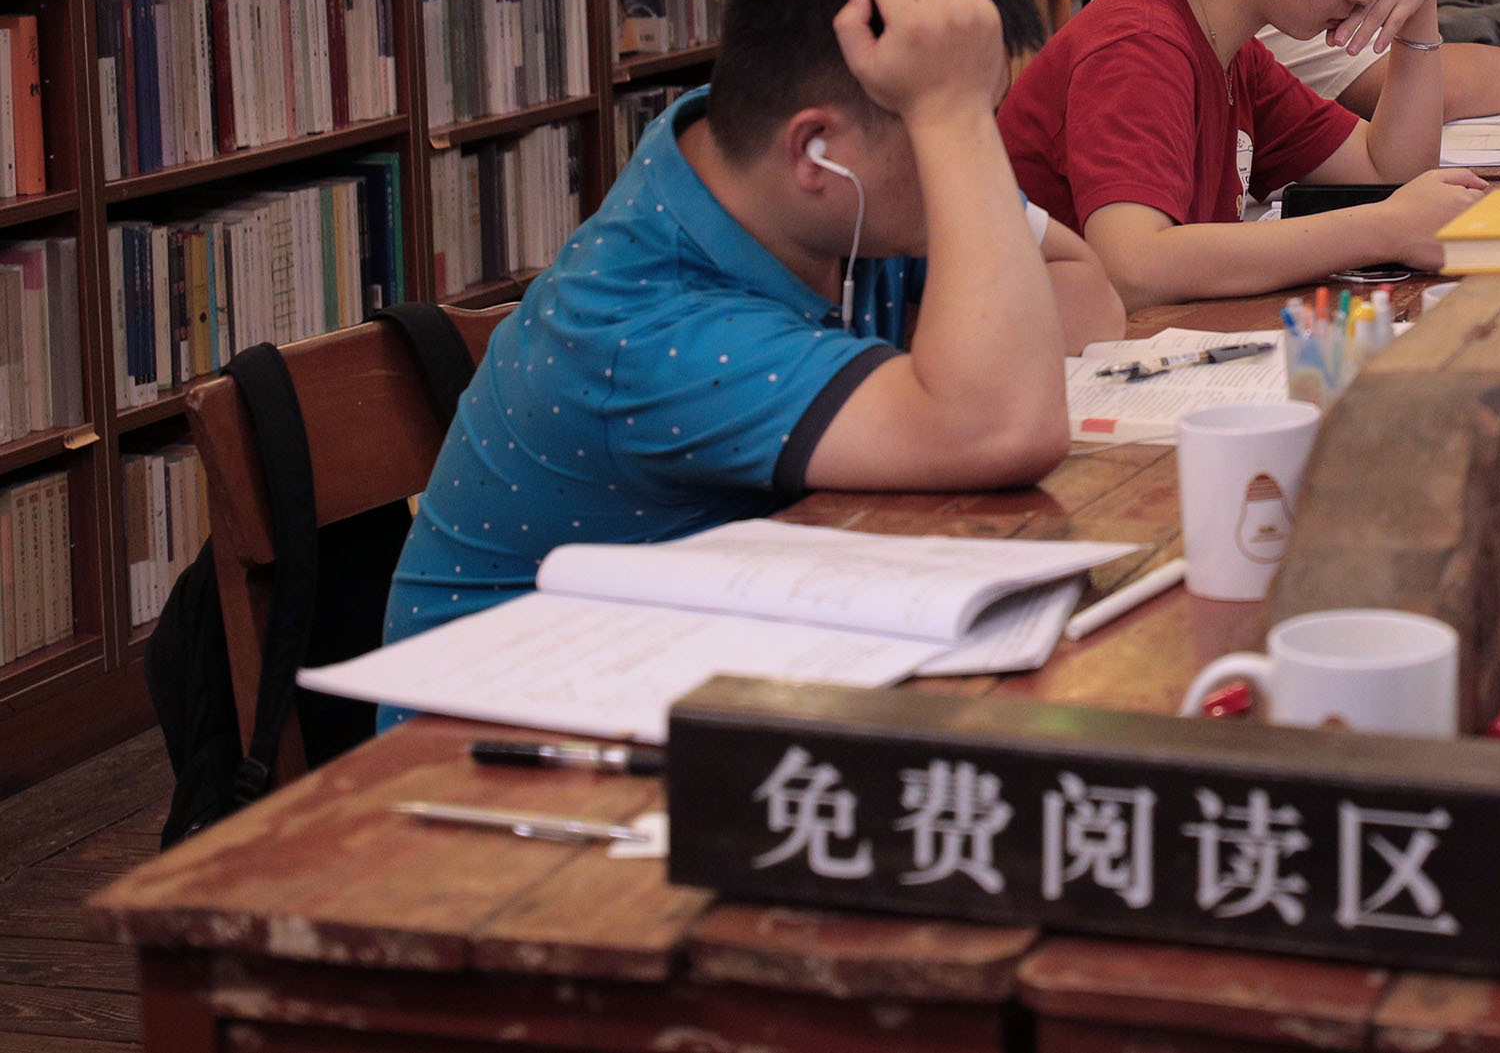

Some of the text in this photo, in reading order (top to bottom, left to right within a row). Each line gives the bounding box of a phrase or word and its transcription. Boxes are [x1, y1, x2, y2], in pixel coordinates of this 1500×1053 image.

[751, 745, 1460, 937] 免费阅读区
